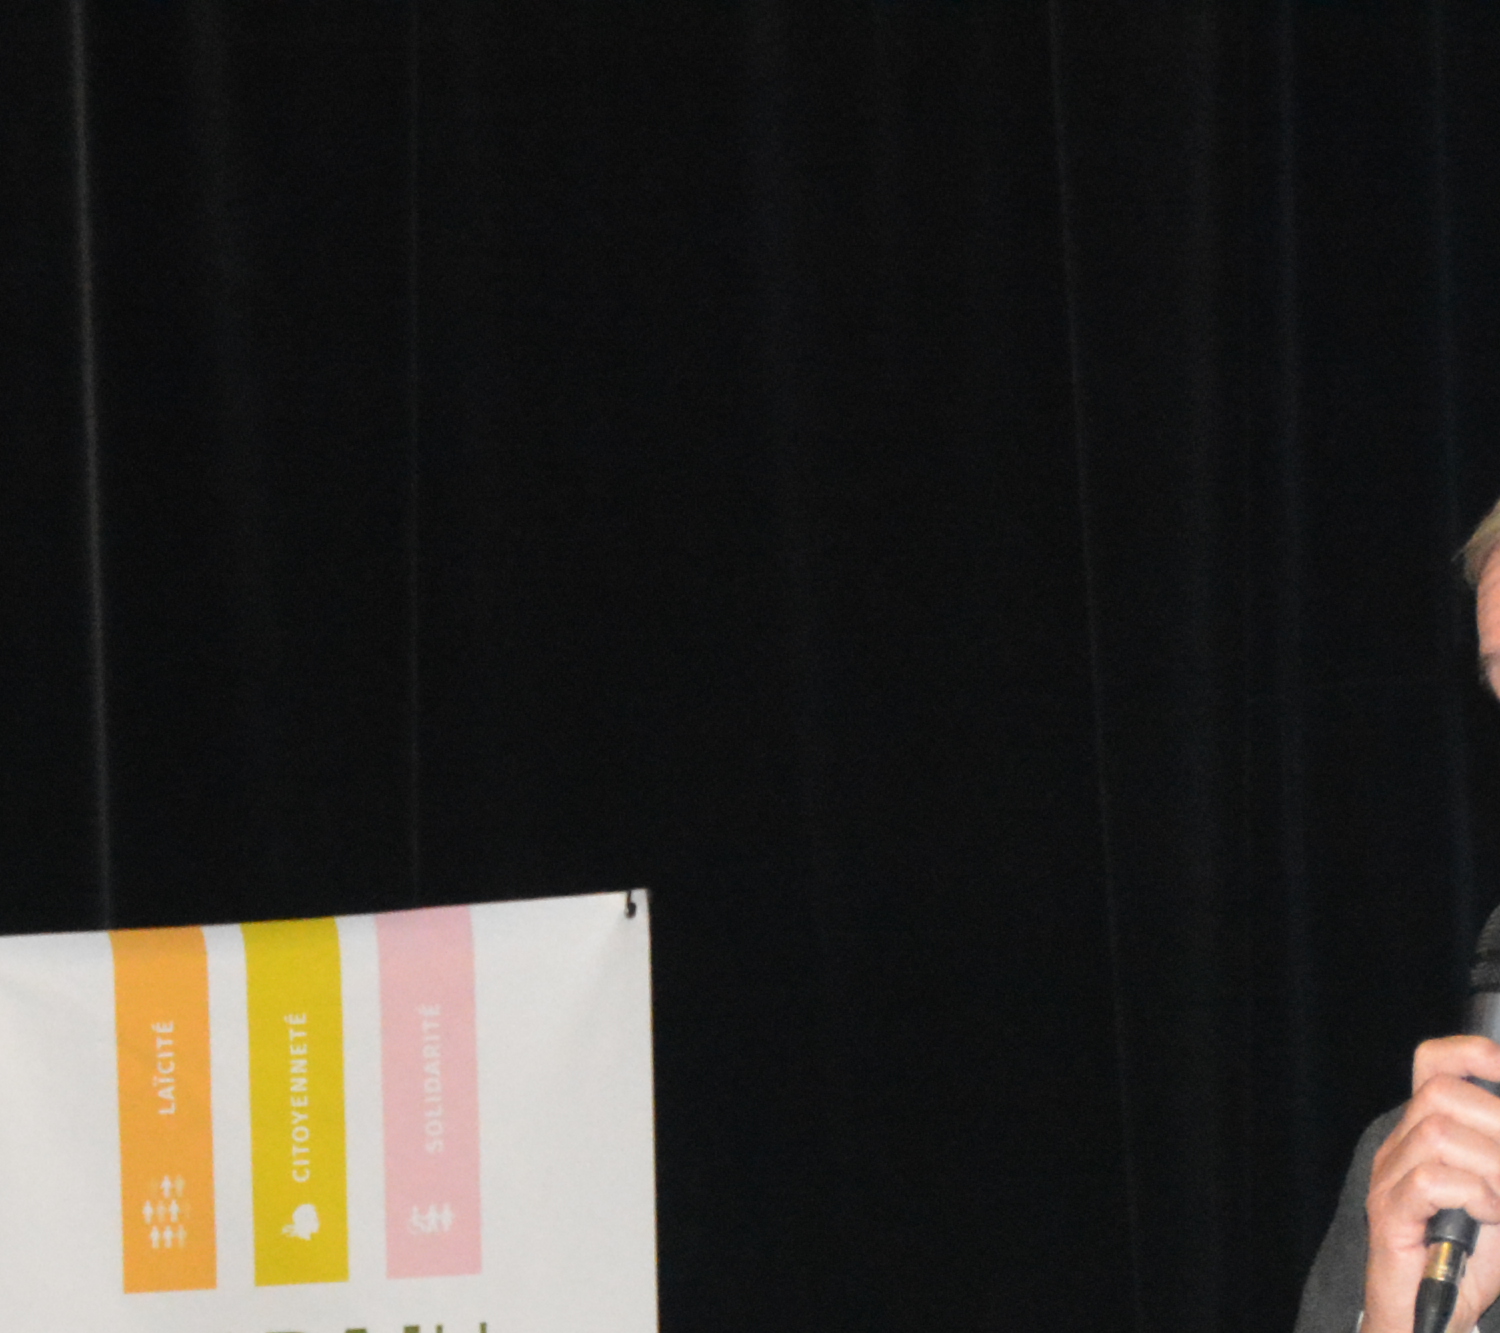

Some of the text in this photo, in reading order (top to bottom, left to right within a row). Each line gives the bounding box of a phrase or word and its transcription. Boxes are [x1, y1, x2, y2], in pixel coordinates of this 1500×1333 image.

[152, 1020, 176, 1115] LAÏCITÉ
[284, 1012, 310, 1183] CITOYENNETÉ
[418, 1003, 445, 1154] SOLIDARITÉ
